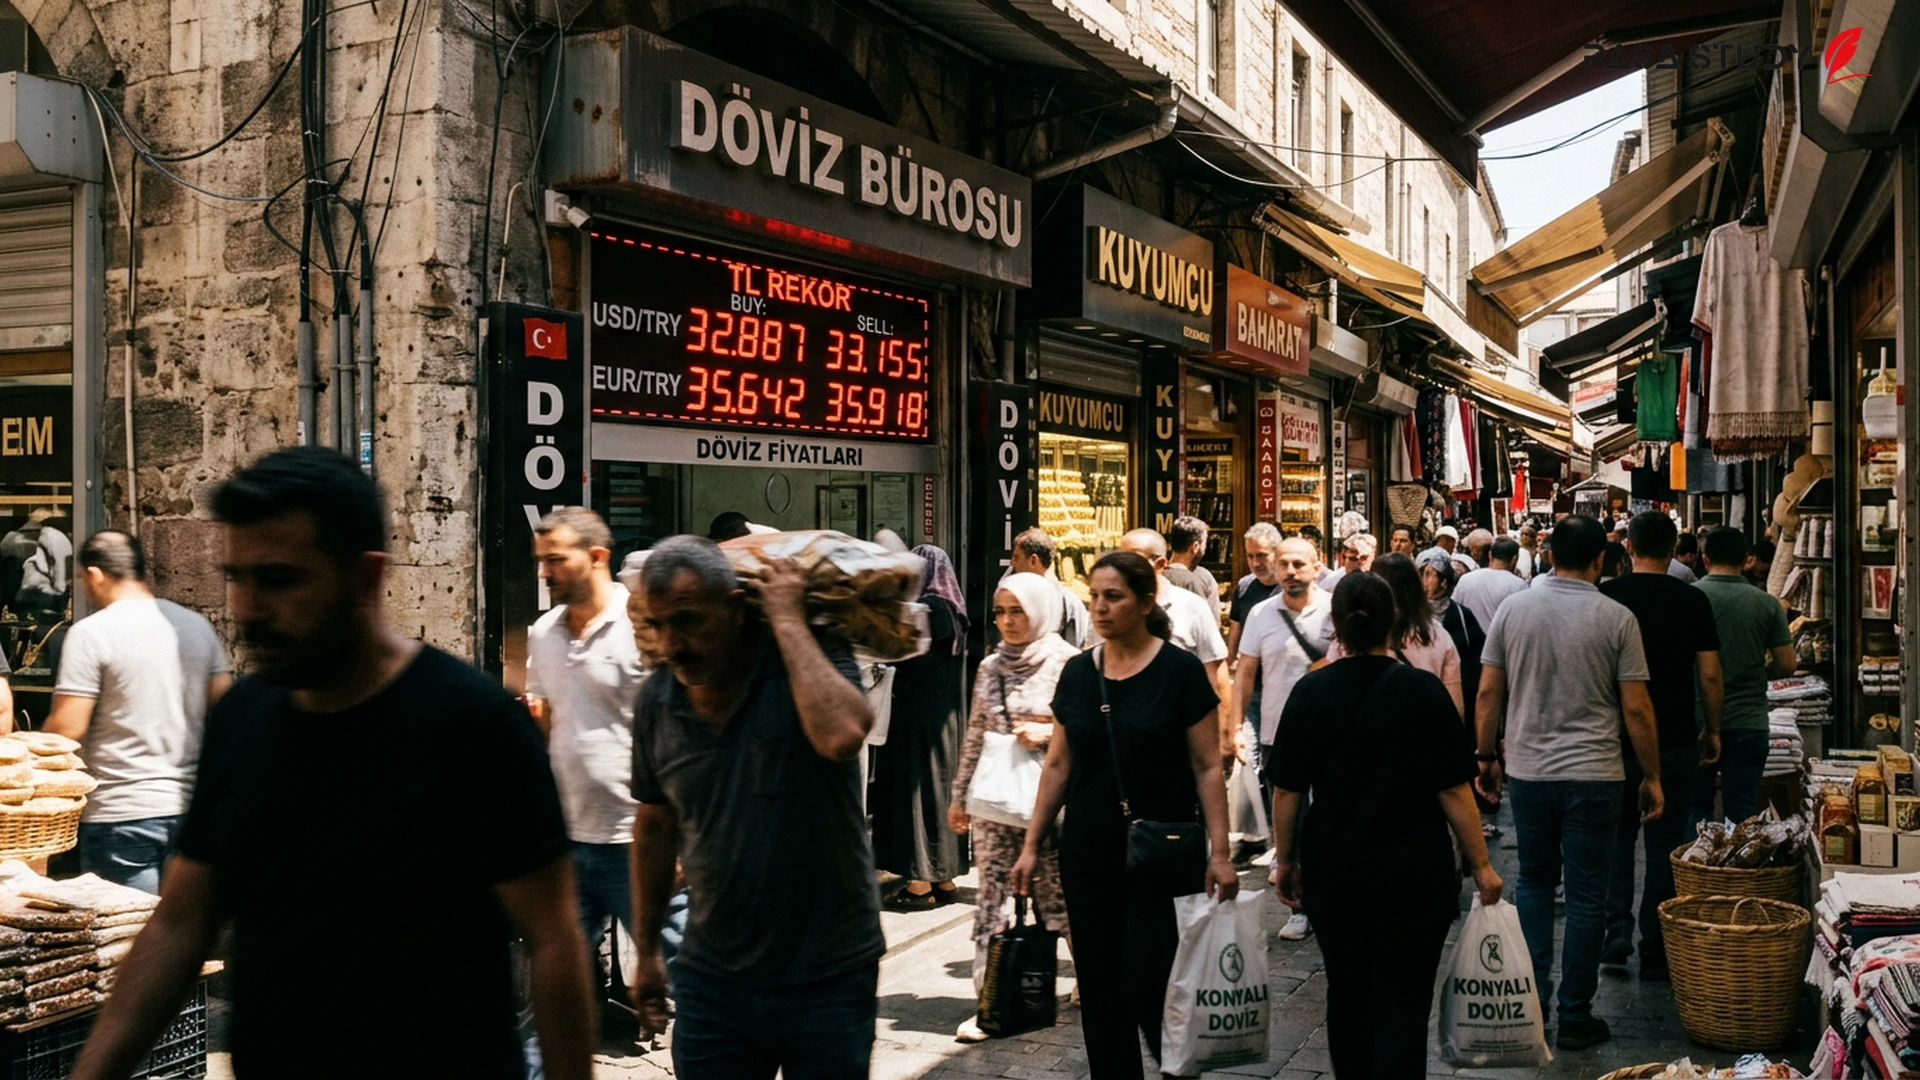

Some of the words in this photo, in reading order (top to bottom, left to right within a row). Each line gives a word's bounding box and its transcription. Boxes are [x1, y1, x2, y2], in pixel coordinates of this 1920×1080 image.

[680, 79, 845, 196] DÖVİZ
[861, 144, 1022, 248] BÜROSU
[728, 263, 760, 296] TL
[1099, 225, 1213, 316] KUYUMCU
[731, 293, 767, 316] BUY:
[592, 301, 682, 337] USD/TRY
[686, 307, 806, 363] 32.887
[826, 329, 922, 380] 33.155
[1237, 302, 1303, 362] BAHARAT
[592, 365, 682, 397] EUR/TRY
[686, 366, 805, 420] 35.642
[825, 381, 923, 429] 35.918
[1039, 391, 1123, 433] KUYUMCU
[697, 435, 762, 462] DÖVİZ
[768, 439, 863, 466] FİYATLARI
[1155, 385, 1174, 550] KUYUM
[1196, 984, 1268, 1007] KONYALI
[1453, 977, 1531, 997] KONYALI
